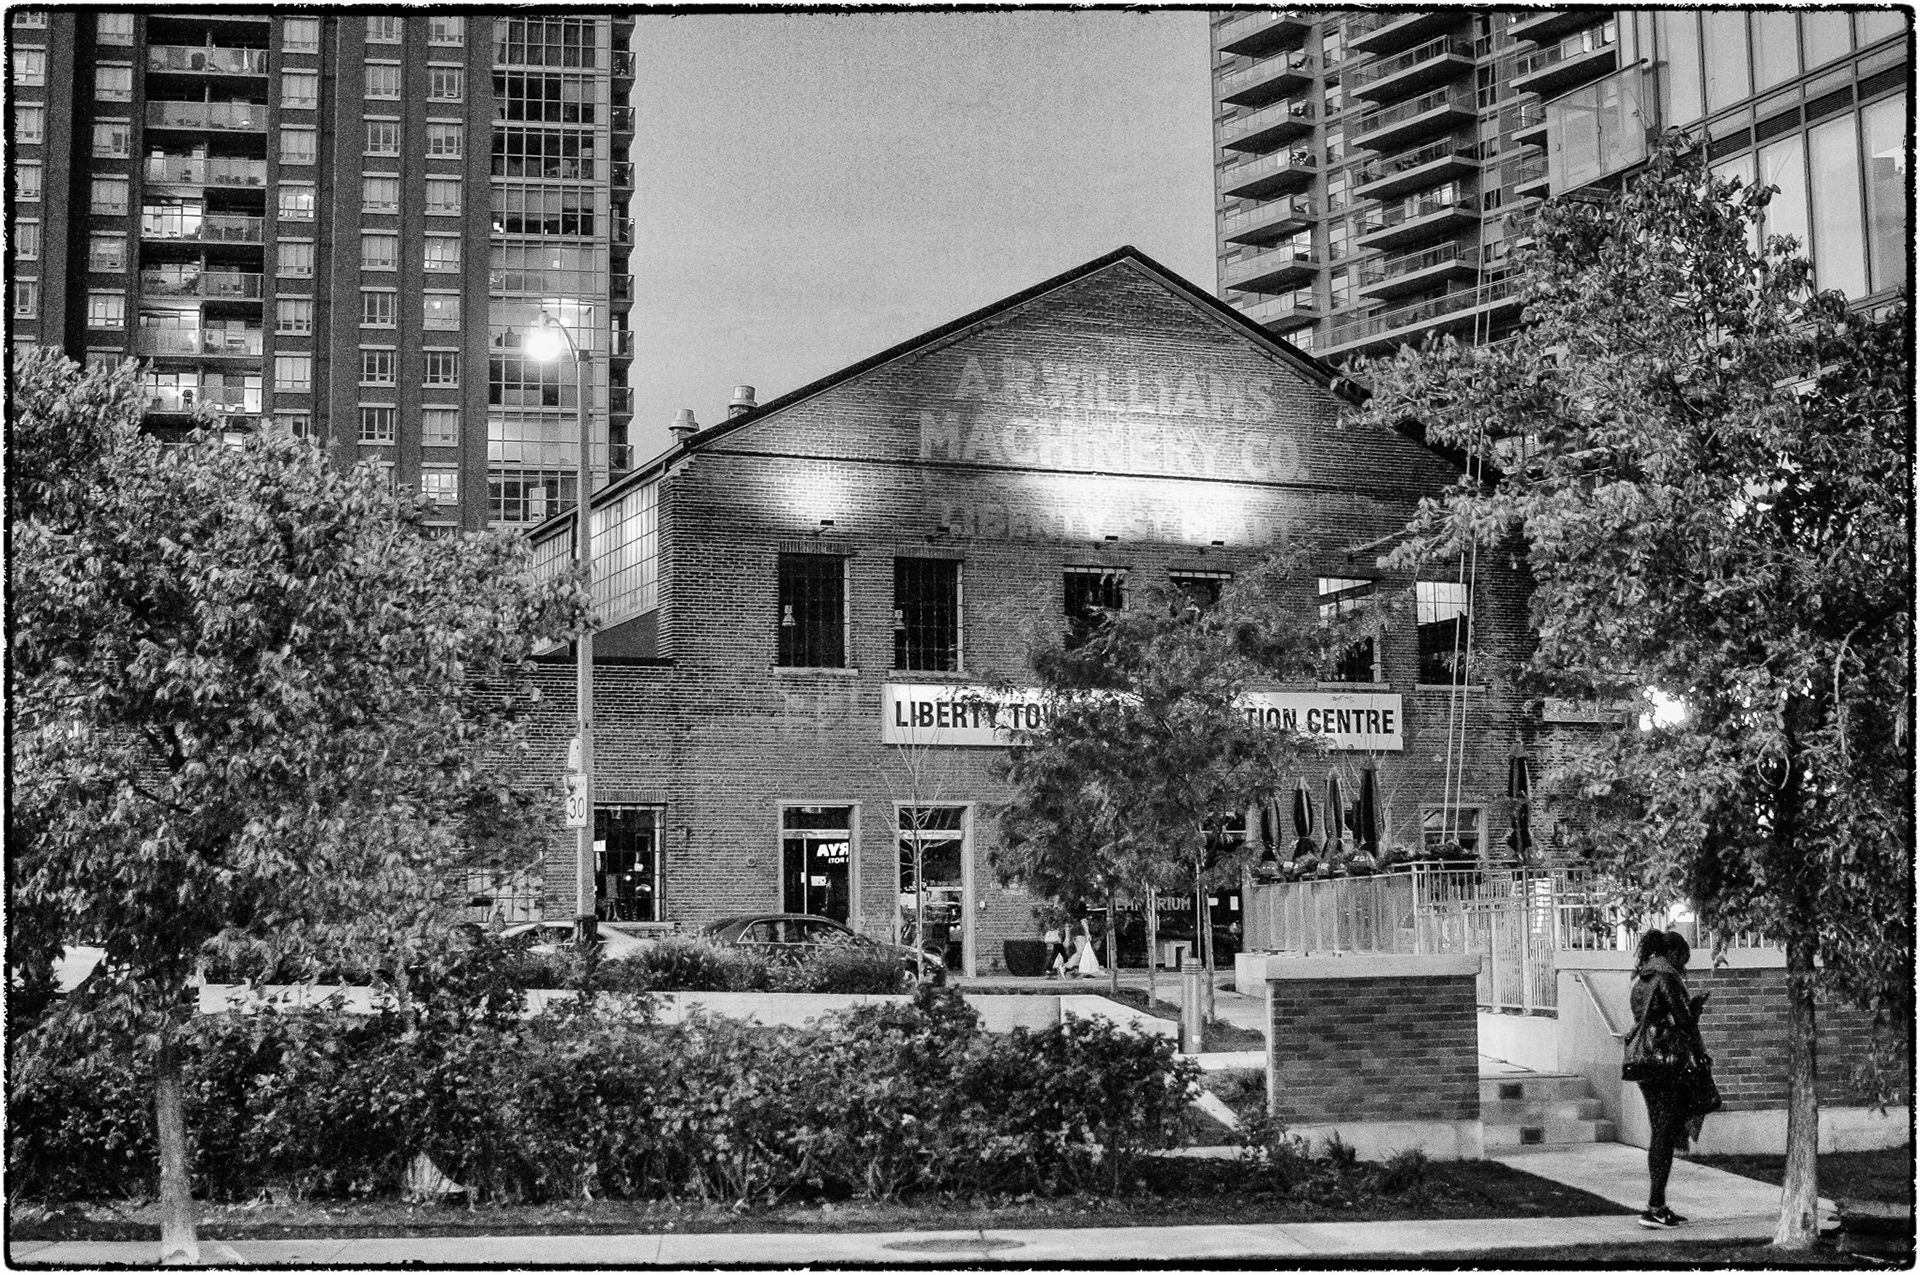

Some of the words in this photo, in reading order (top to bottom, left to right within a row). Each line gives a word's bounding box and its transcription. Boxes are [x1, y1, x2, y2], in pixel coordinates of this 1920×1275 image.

[919, 412, 1227, 475] MACHINERY
[1241, 434, 1309, 481] CO.
[895, 700, 1001, 729] LIBERTY
[1307, 708, 1395, 735] CENTRE
[570, 797, 584, 819] 30
[1115, 896, 1191, 911] EMRIUM
